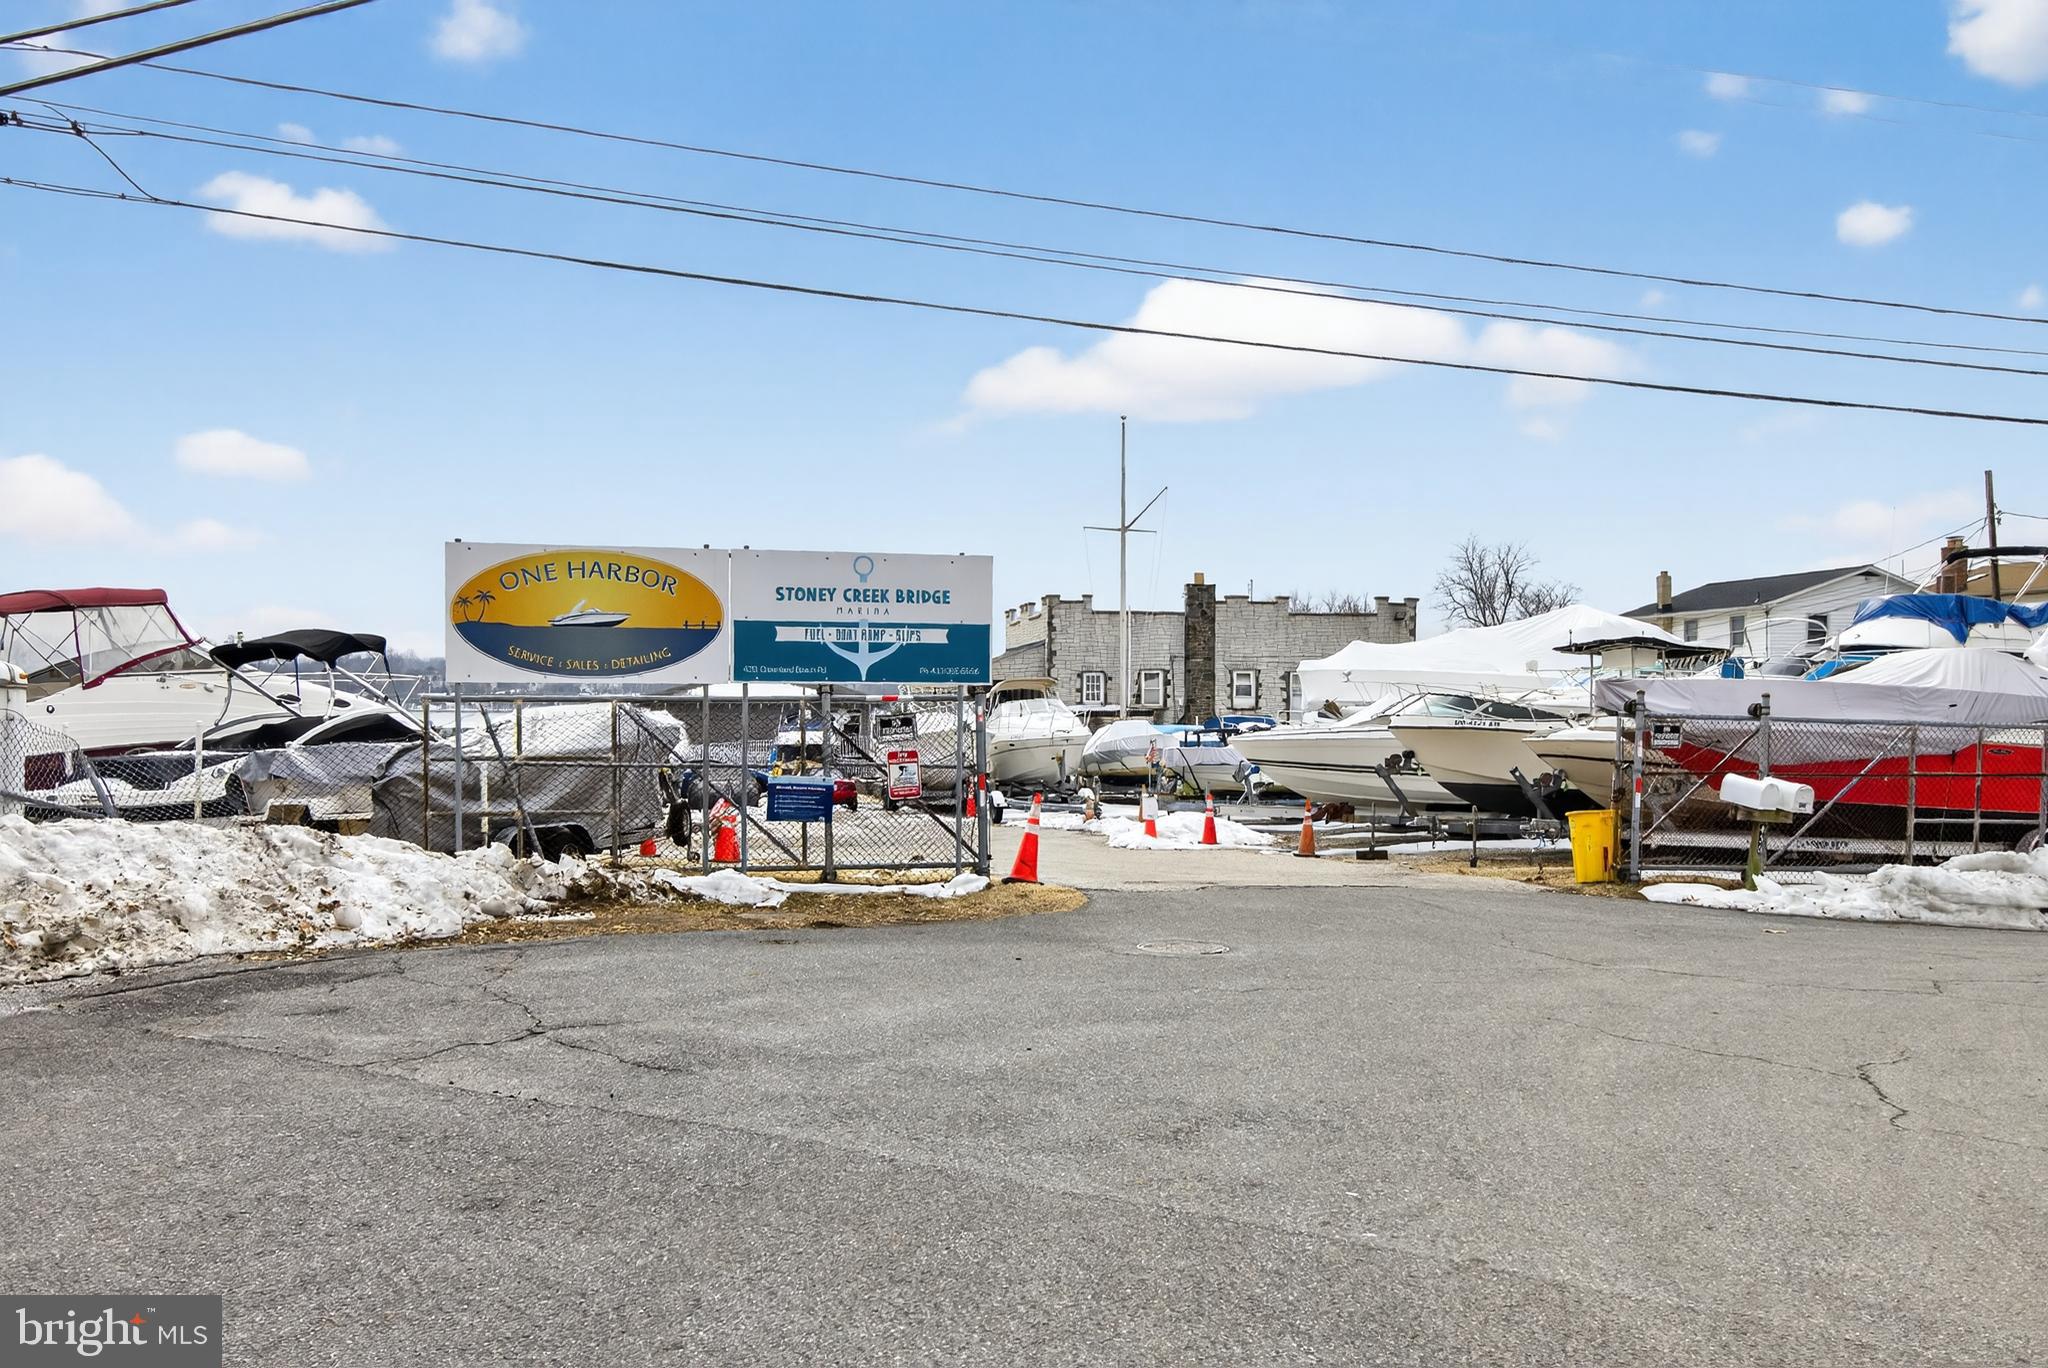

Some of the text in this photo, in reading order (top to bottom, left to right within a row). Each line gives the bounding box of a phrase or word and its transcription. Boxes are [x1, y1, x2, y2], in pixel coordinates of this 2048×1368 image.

[499, 561, 678, 596] ONE HARBOR
[775, 586, 951, 605] STONEY CREEK BRIDGE
[836, 607, 890, 616] MARINA
[804, 628, 826, 641] FUEL
[508, 645, 672, 671] SERVICE SALES DETAILING
